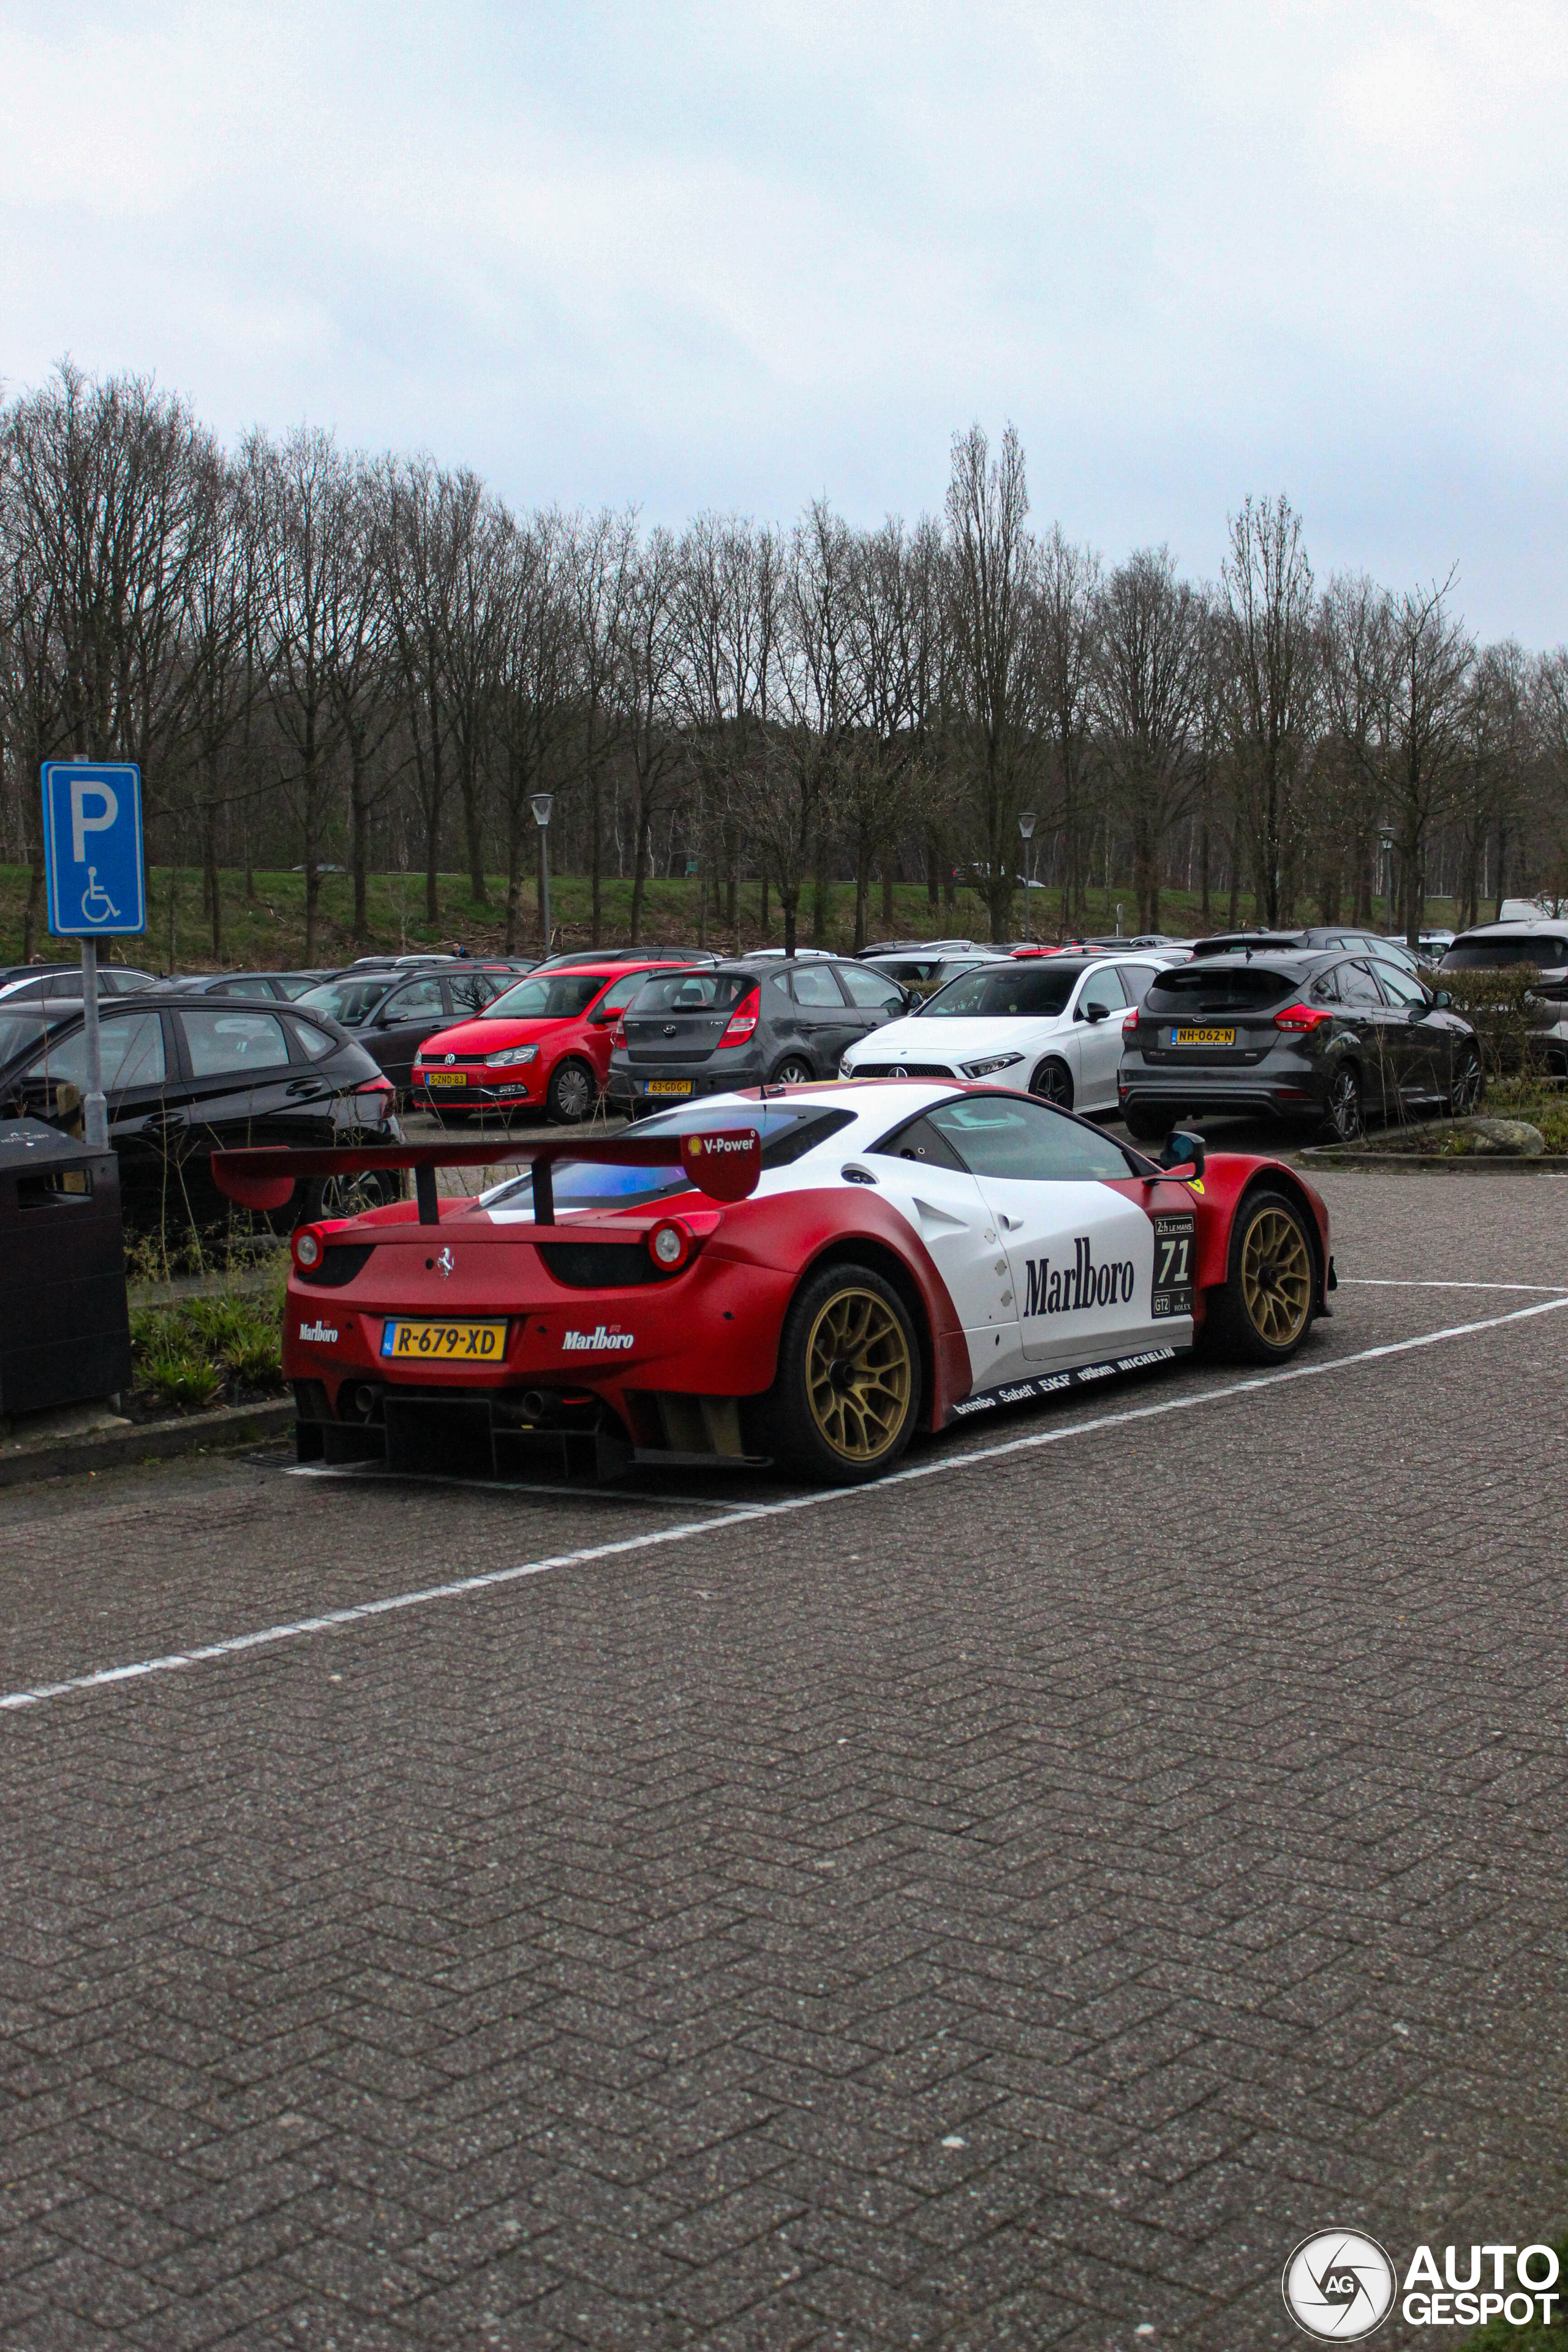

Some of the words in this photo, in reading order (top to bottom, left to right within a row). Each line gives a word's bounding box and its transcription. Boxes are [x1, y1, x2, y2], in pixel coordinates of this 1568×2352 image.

[70, 780, 118, 862] P
[1179, 1030, 1232, 1041] NH-062-N
[431, 1075, 464, 1084] 5-ZND-83
[652, 1082, 688, 1091] 63-GDG-1
[704, 1138, 754, 1154] V-Power
[1158, 1239, 1189, 1284] 71
[1023, 1237, 1134, 1317] Marlboro
[1155, 1298, 1169, 1312] GT2
[1174, 1303, 1191, 1312] ROLEX
[299, 1321, 338, 1343] Marlboro
[398, 1328, 496, 1354] R-679-XD
[562, 1326, 635, 1349] Marlboro
[952, 1396, 997, 1415] brembo
[998, 1384, 1036, 1403] Sabelt
[1038, 1374, 1071, 1392] SKF
[1077, 1365, 1116, 1382] rotiform
[1117, 1348, 1175, 1371] MICHELIN
